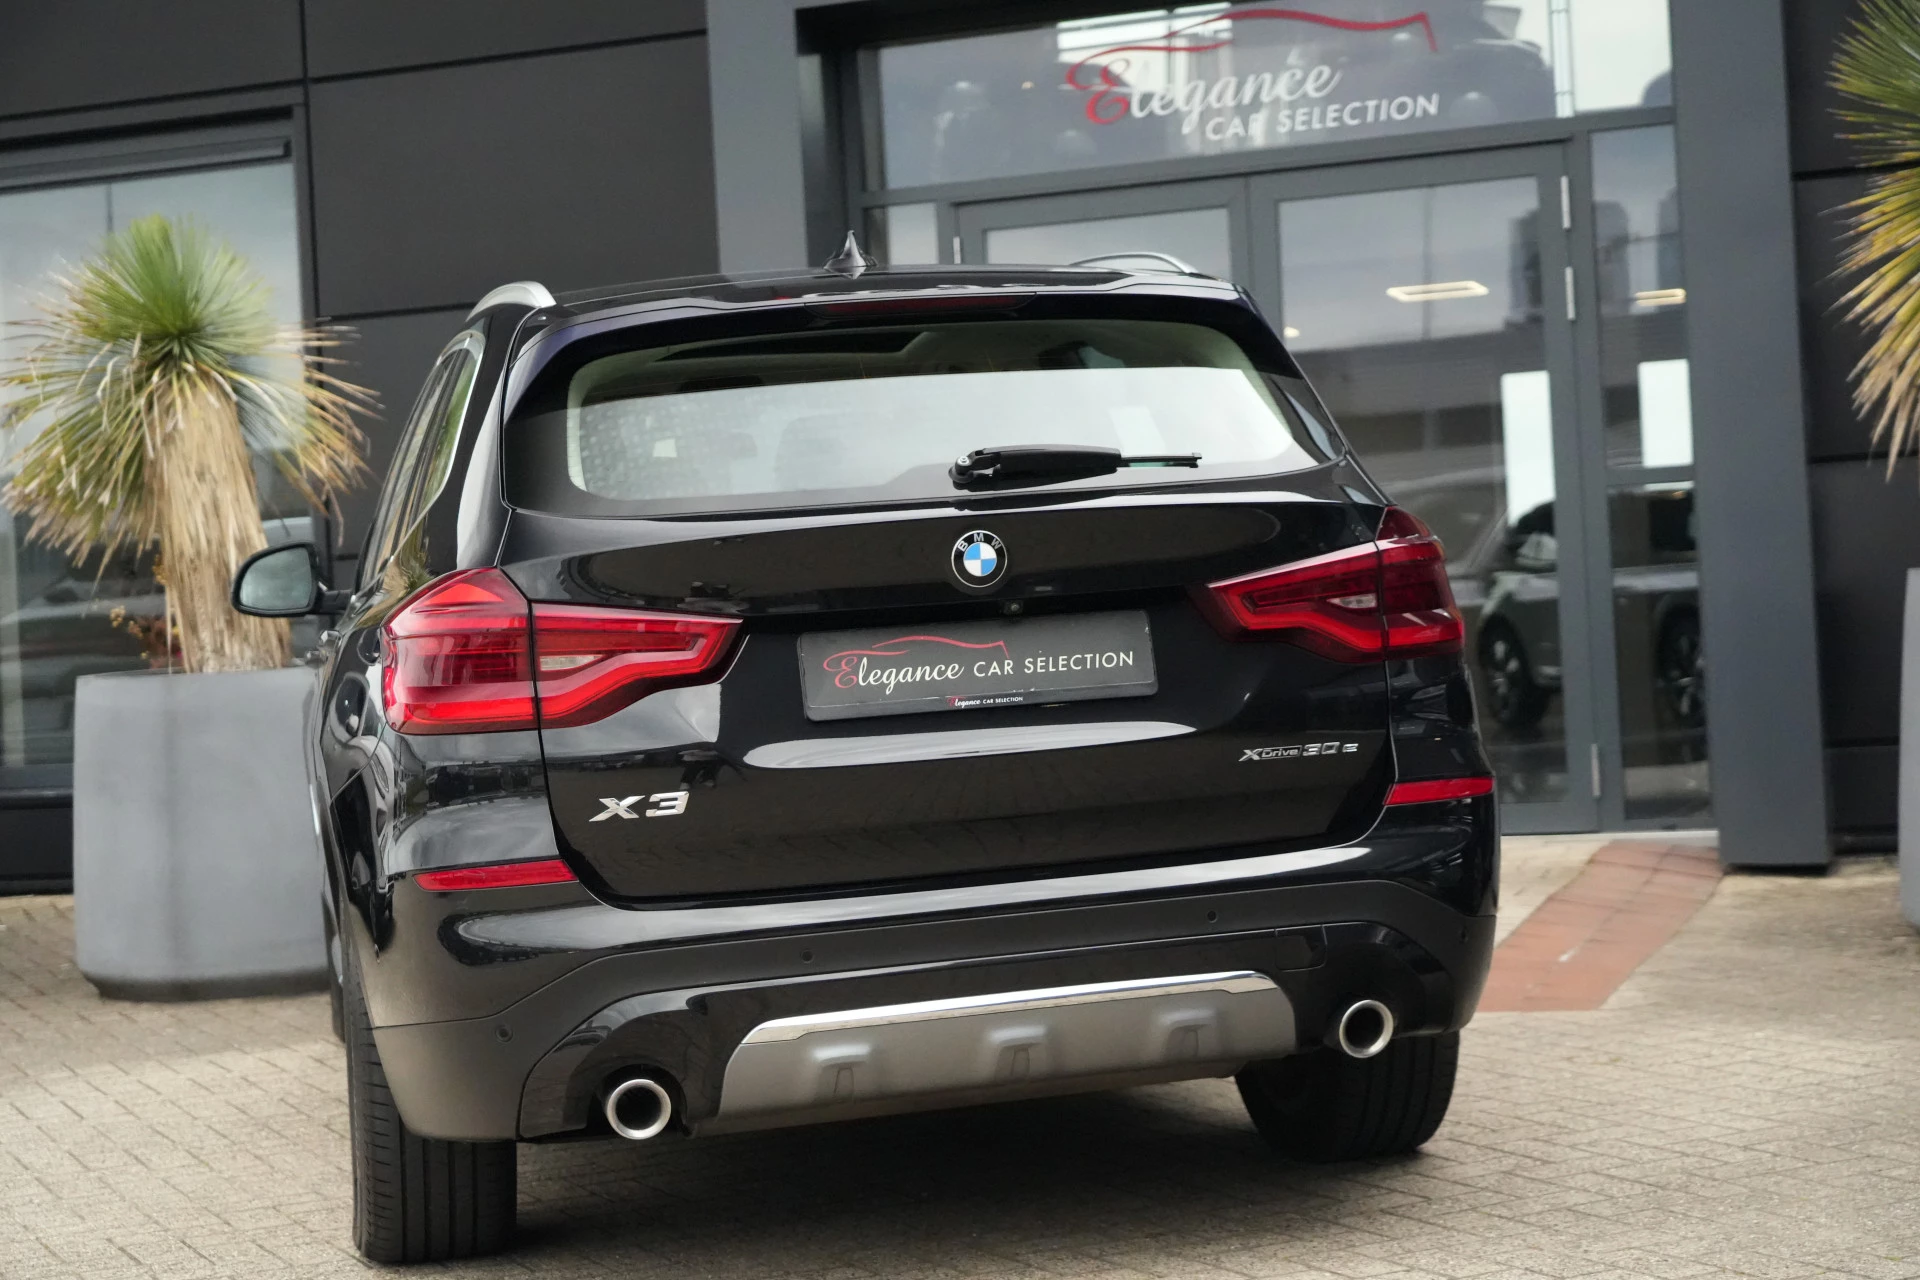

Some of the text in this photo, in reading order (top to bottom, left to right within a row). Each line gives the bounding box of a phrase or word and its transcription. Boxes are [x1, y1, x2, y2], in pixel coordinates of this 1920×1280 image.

[1277, 93, 1440, 134] SELECTION
[957, 532, 1001, 552] BMW
[823, 650, 1134, 696] Elegance CAR SELECTION
[588, 791, 690, 821] X3
